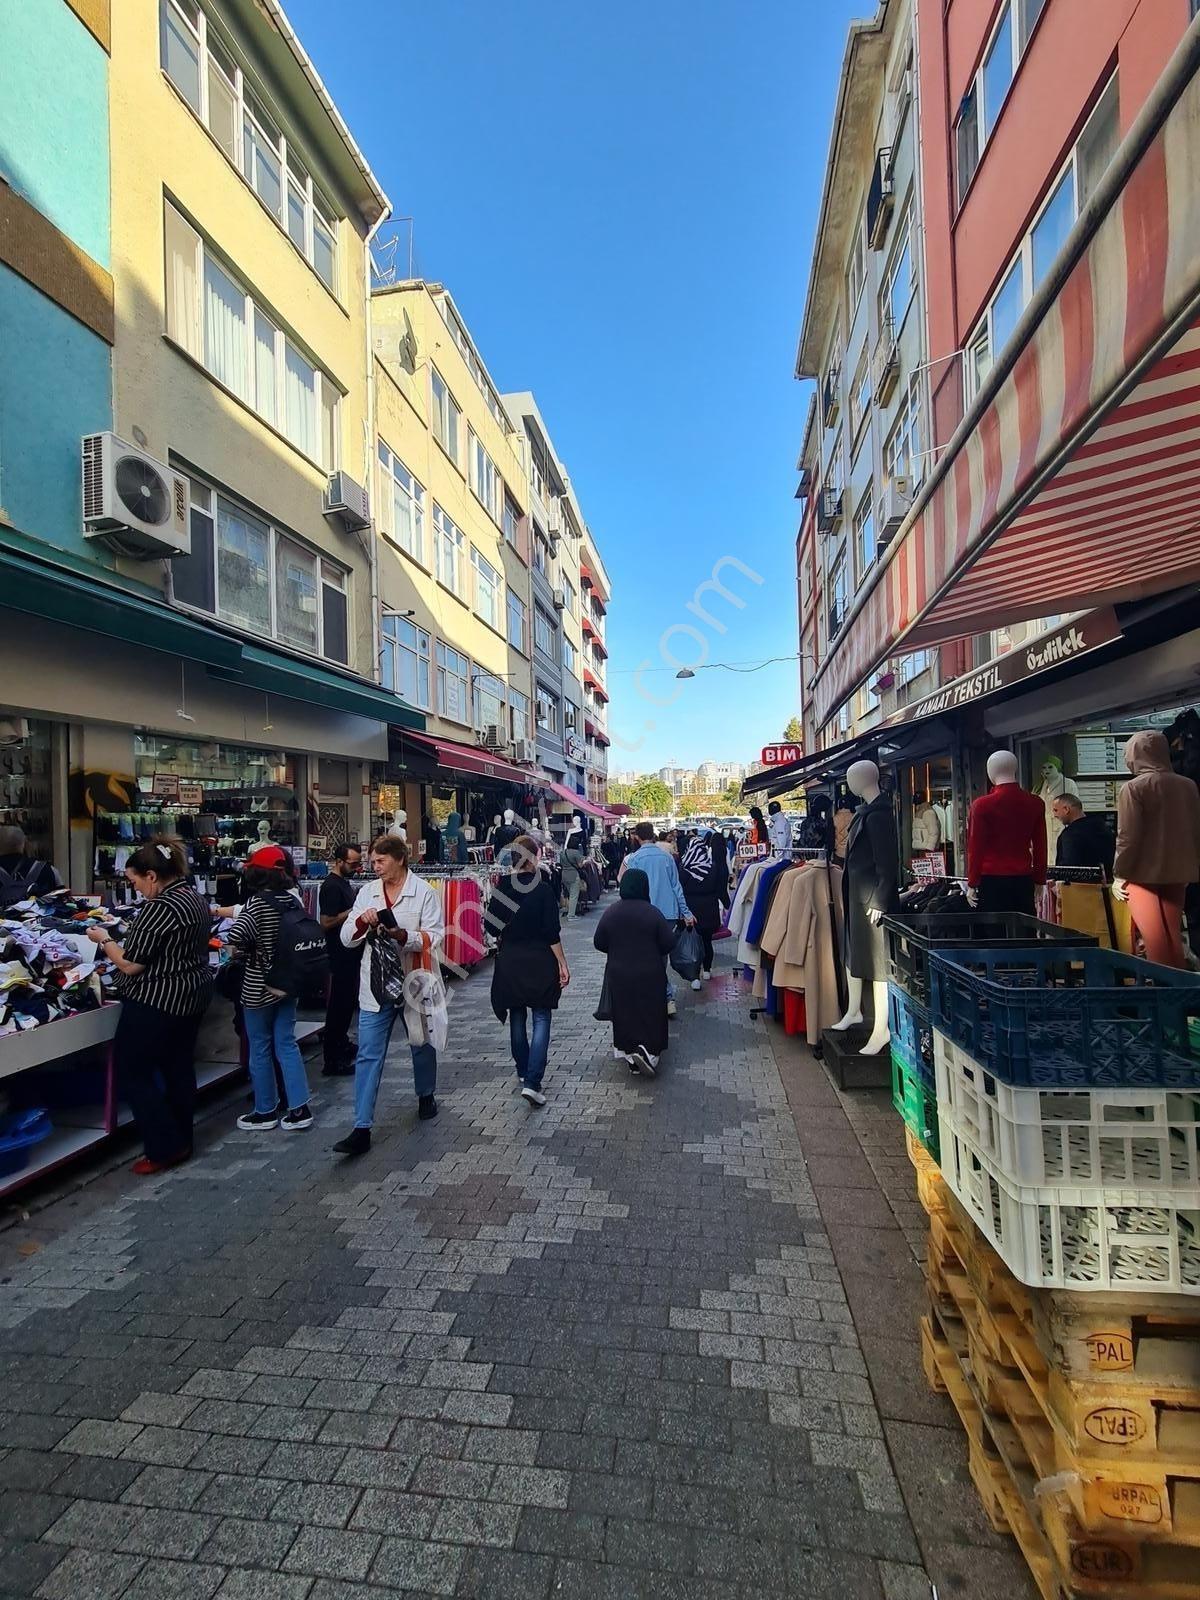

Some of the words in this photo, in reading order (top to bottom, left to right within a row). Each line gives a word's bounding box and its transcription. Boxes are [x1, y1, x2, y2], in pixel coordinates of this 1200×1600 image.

[1026, 627, 1087, 670] Özdilek
[912, 690, 952, 719] KANAAT
[765, 747, 797, 762] BİM
[740, 846, 754, 855] 100
[1086, 1341, 1131, 1362] EPAL
[1092, 1414, 1138, 1437] EPAL
[1104, 1487, 1159, 1507] URPAL
[1120, 1503, 1141, 1516] 027
